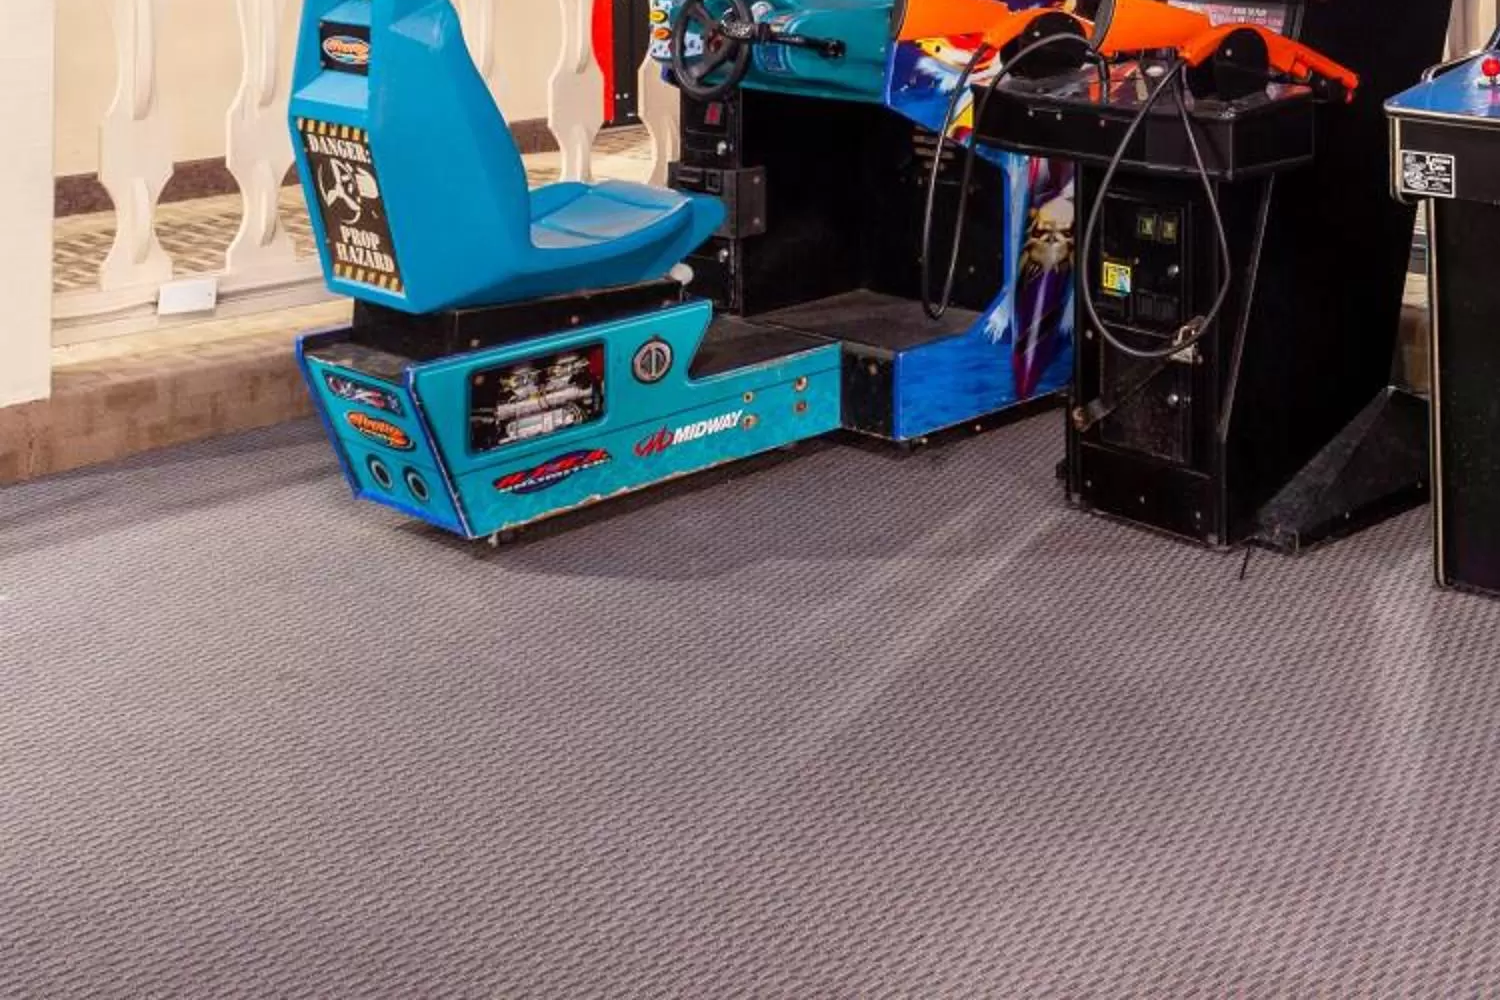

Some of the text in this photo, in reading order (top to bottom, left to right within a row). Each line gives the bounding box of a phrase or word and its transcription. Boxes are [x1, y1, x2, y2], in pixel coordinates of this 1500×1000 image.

[339, 224, 381, 250] PROP
[335, 243, 395, 273] HAZARD
[671, 408, 744, 445] MIDWAY
